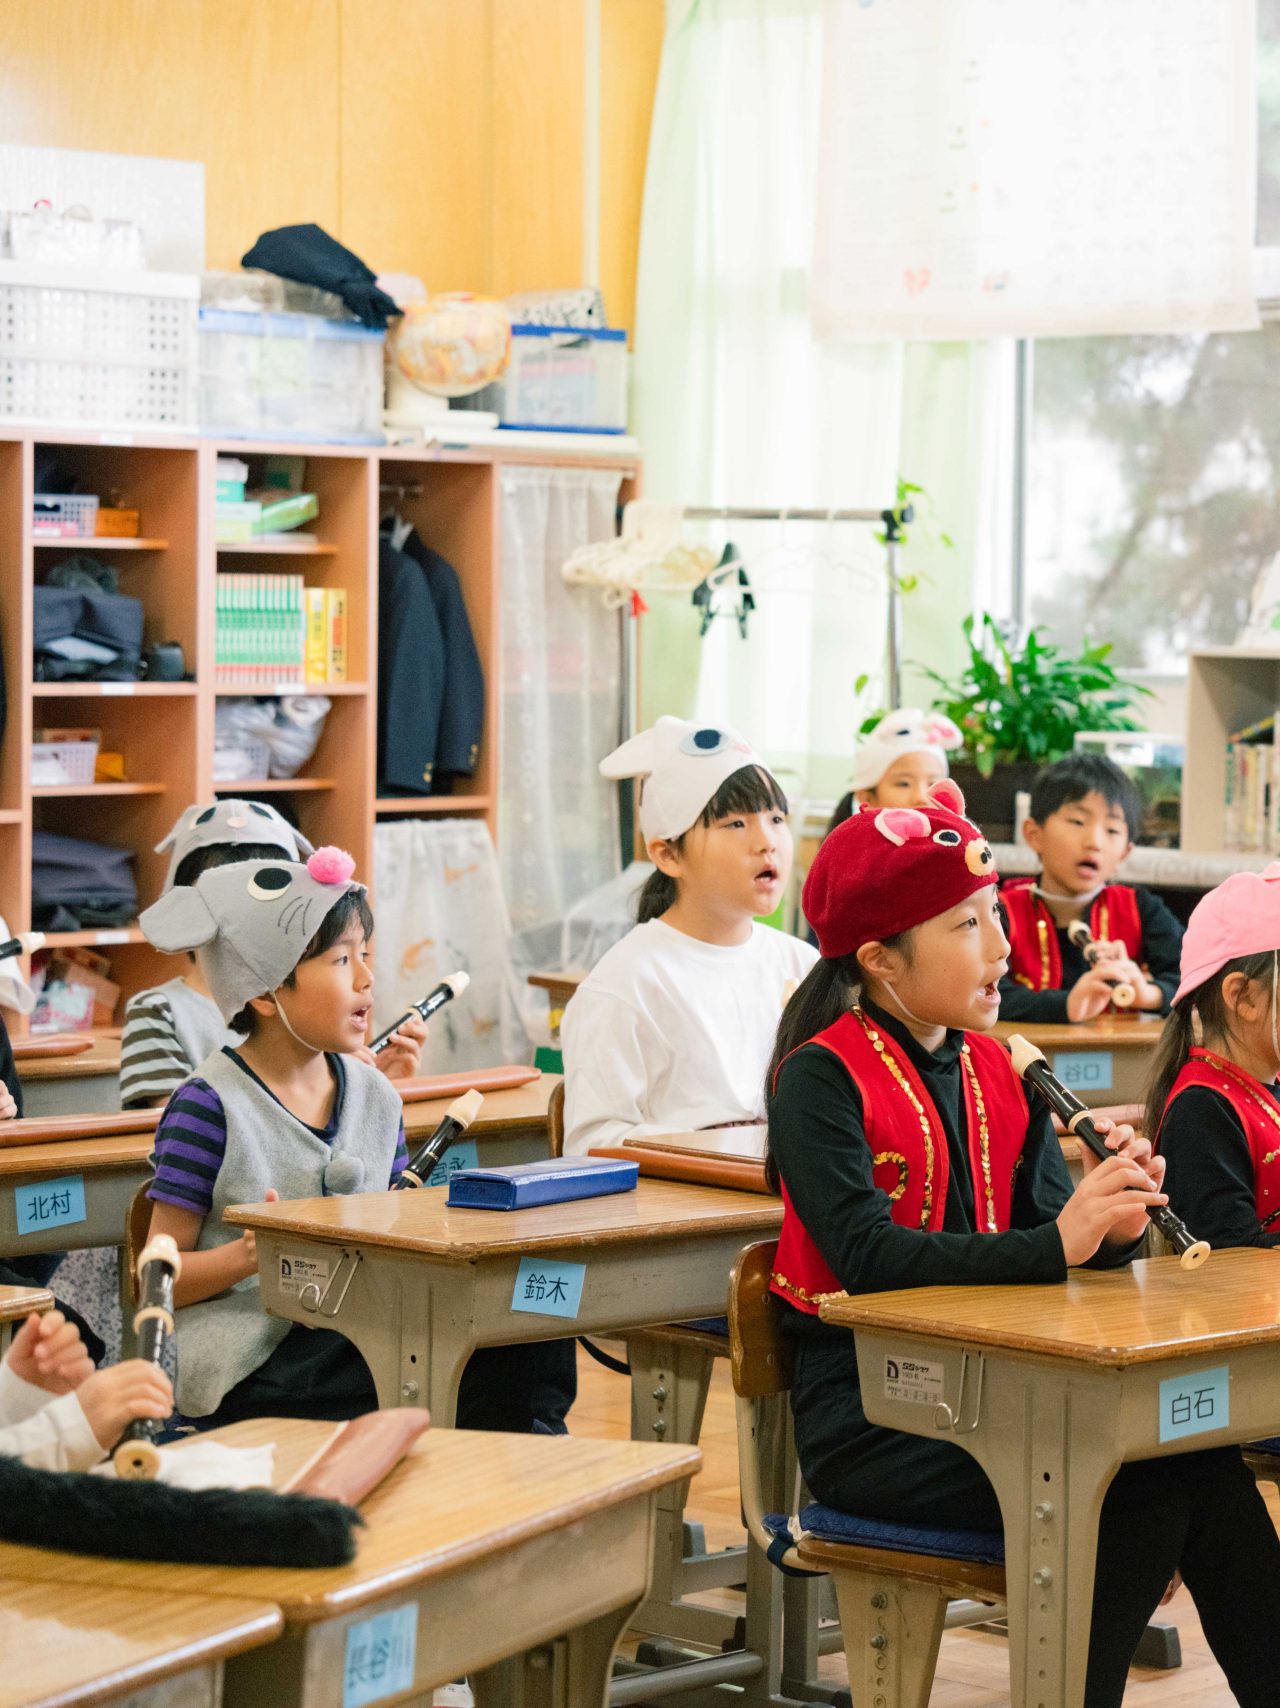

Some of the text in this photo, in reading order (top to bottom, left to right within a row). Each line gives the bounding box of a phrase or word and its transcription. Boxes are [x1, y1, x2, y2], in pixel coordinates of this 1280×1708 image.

[1065, 1062, 1099, 1082] 谷口
[27, 1189, 72, 1220] 北村
[524, 1273, 569, 1304] 鈴木
[1171, 1387, 1215, 1425] 白石
